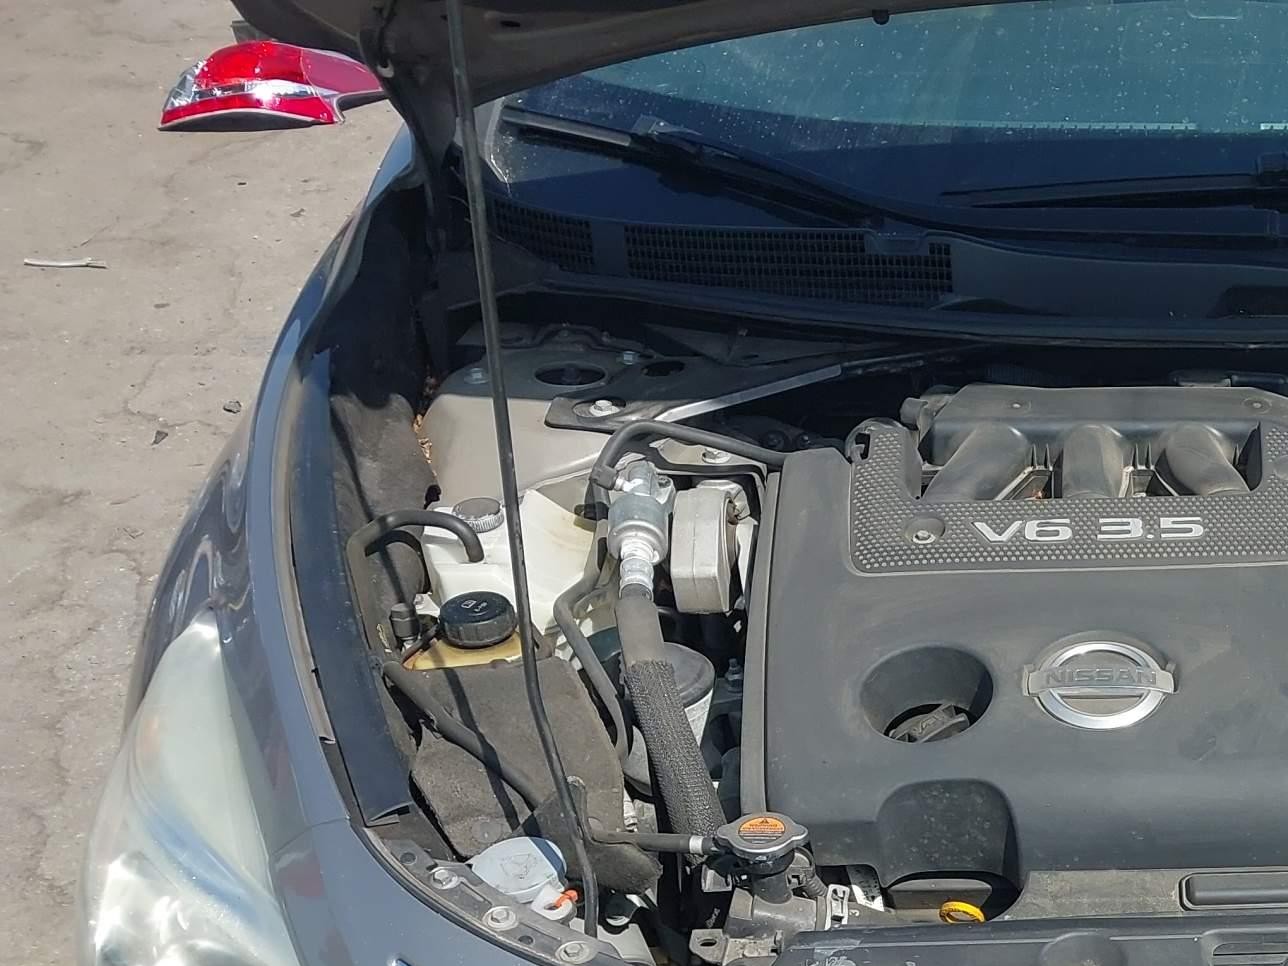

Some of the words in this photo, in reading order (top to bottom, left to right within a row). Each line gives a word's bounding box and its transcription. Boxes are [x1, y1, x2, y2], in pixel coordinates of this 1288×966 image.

[972, 519, 1072, 543] V6
[1097, 517, 1204, 540] 3.5
[1046, 668, 1157, 686] NISSAN
